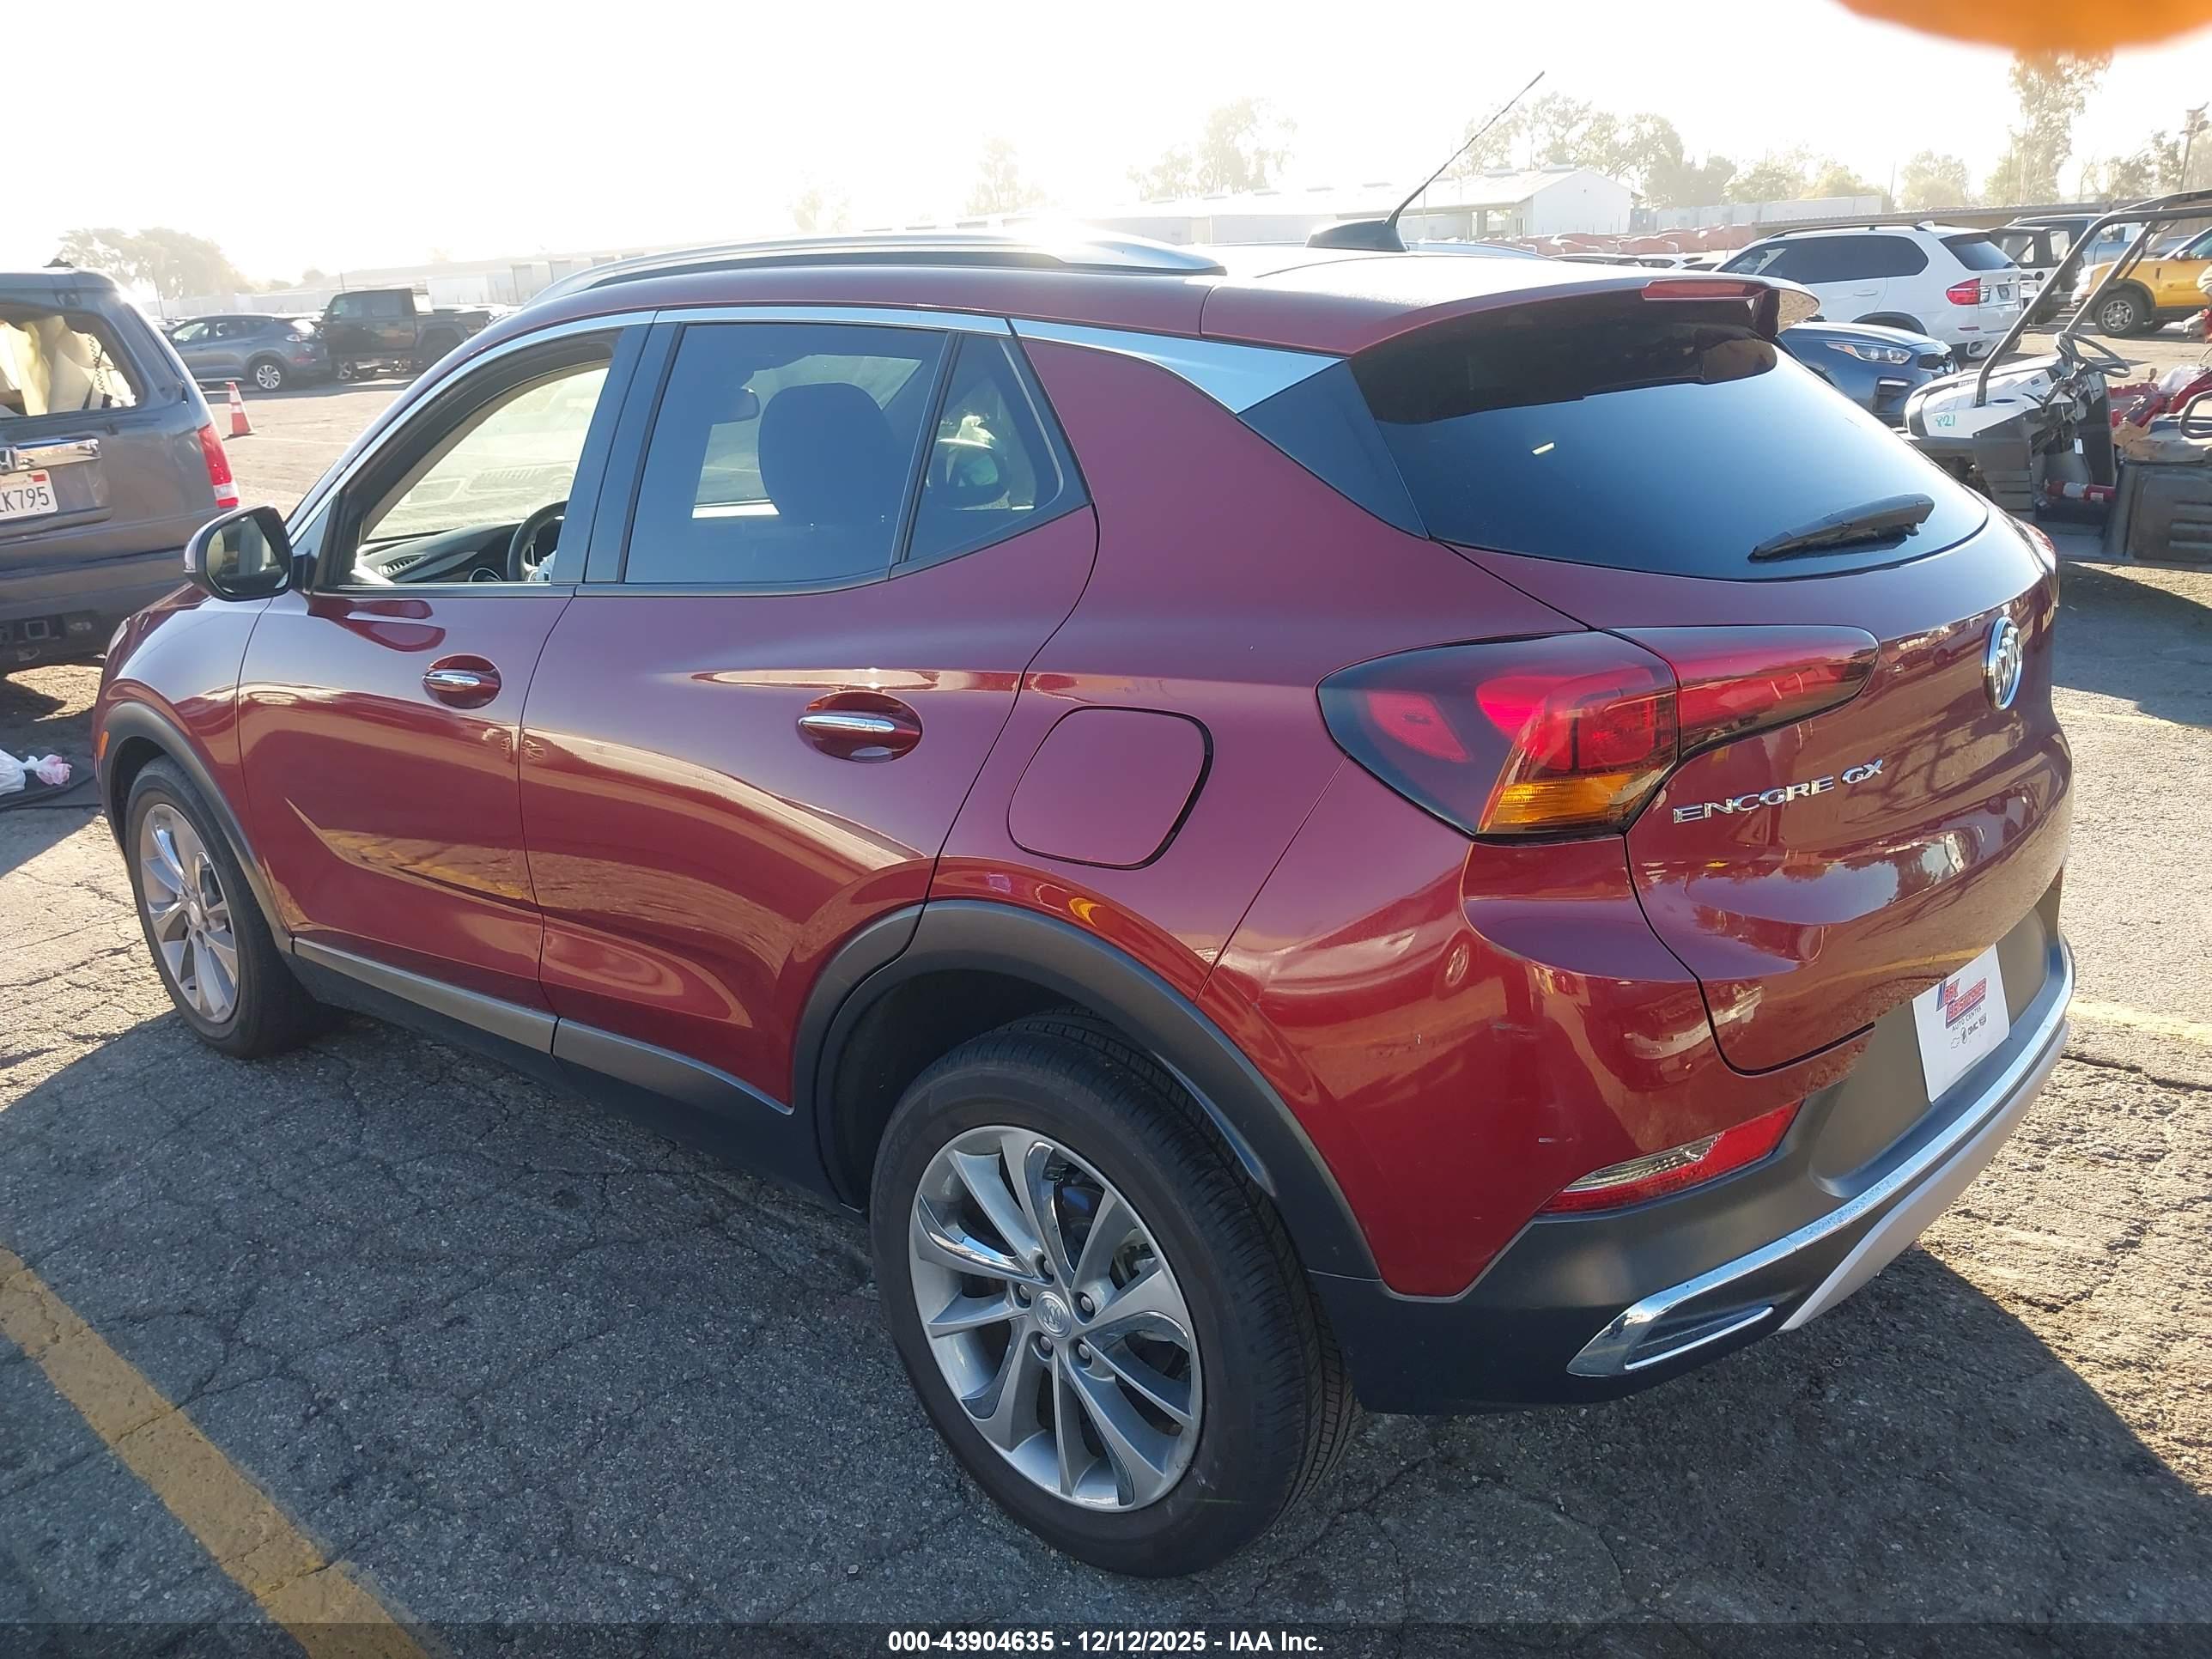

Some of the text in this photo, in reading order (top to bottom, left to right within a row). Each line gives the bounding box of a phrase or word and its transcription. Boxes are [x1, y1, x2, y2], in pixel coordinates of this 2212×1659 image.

[1673, 757, 1883, 824] ENCORE GX
[1951, 1005, 1982, 1031] AUTO CENTER
[1967, 1021, 1979, 1036] GMC
